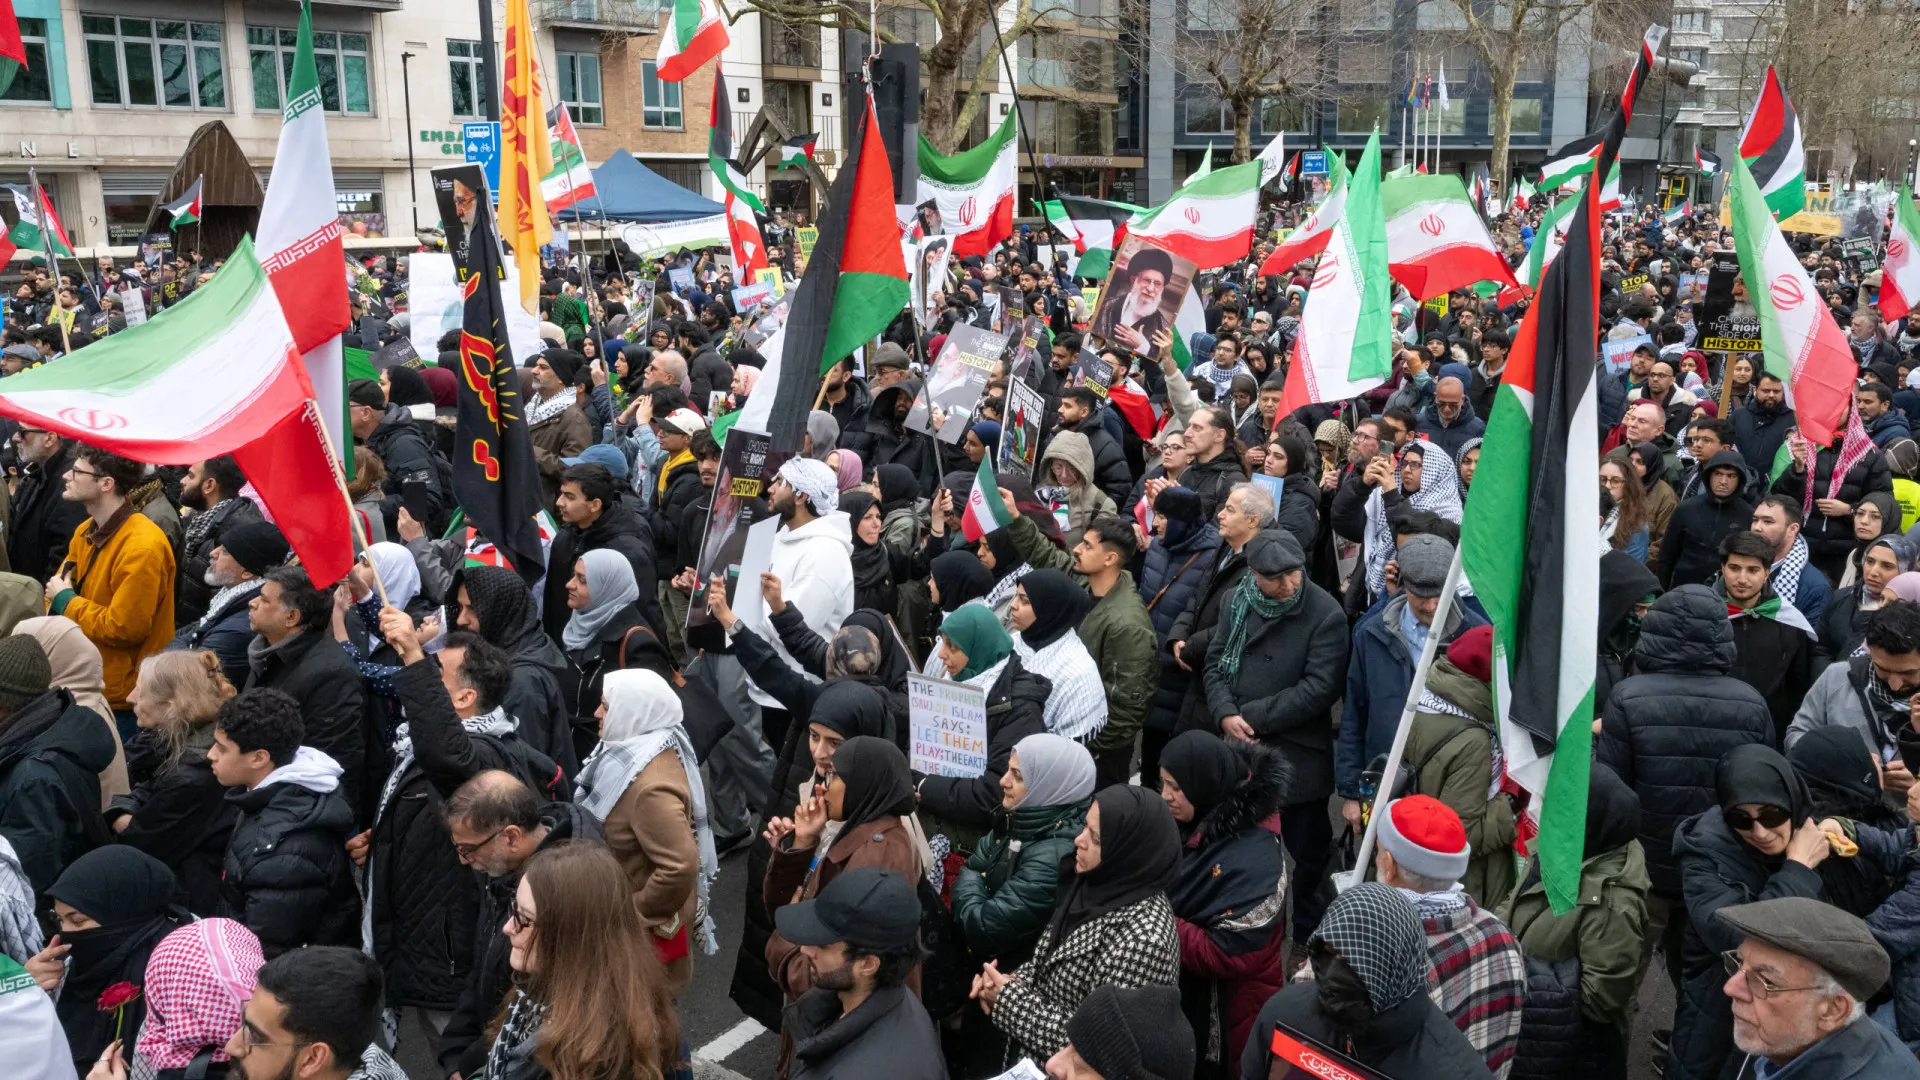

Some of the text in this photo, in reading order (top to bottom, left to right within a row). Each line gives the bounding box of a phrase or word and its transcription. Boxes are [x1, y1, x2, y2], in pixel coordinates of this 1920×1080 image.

[89, 216, 98, 227] 9
[800, 232, 817, 243] STOP
[1622, 275, 1648, 288] STOP
[1710, 322, 1730, 331] THE
[981, 334, 1007, 346] CHOOSE
[1718, 331, 1740, 339] SIDE
[971, 338, 1003, 352] THE RIGHT
[1608, 343, 1625, 353] STOP
[1706, 339, 1762, 350] HISTORY
[977, 348, 1000, 360] SIDE OF
[1611, 354, 1625, 364] WAR
[960, 354, 994, 369] HISTORY
[1085, 377, 1108, 398] HISTORY
[748, 440, 769, 454] CHOOSE
[741, 451, 767, 466] THE RIGHT
[745, 465, 755, 477] SIDE
[732, 479, 759, 496] HISTORY
[911, 682, 984, 708] THE PROPHET
[936, 703, 948, 713] OF
[952, 706, 983, 724] ISLAM
[933, 716, 972, 735] SAYS:
[943, 732, 985, 754] THEM
[923, 760, 940, 775] THE
